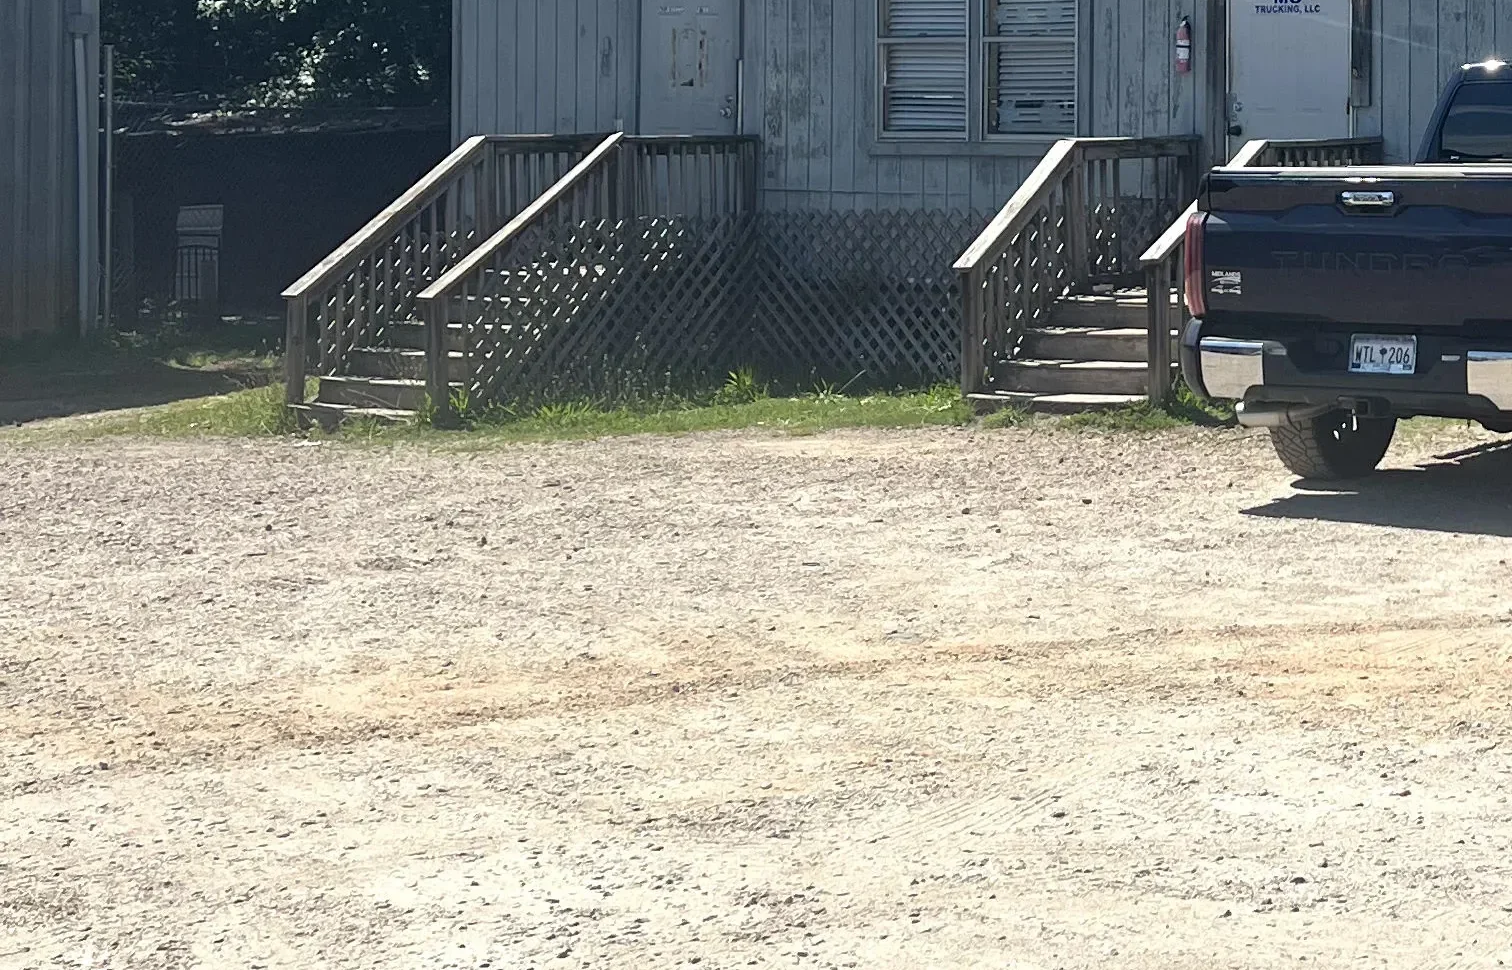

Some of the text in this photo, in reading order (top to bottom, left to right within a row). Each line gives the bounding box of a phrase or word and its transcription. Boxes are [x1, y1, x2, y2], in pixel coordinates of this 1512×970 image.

[1255, 5, 1321, 14] TRUCKING, LLC
[1388, 346, 1411, 364] 206
